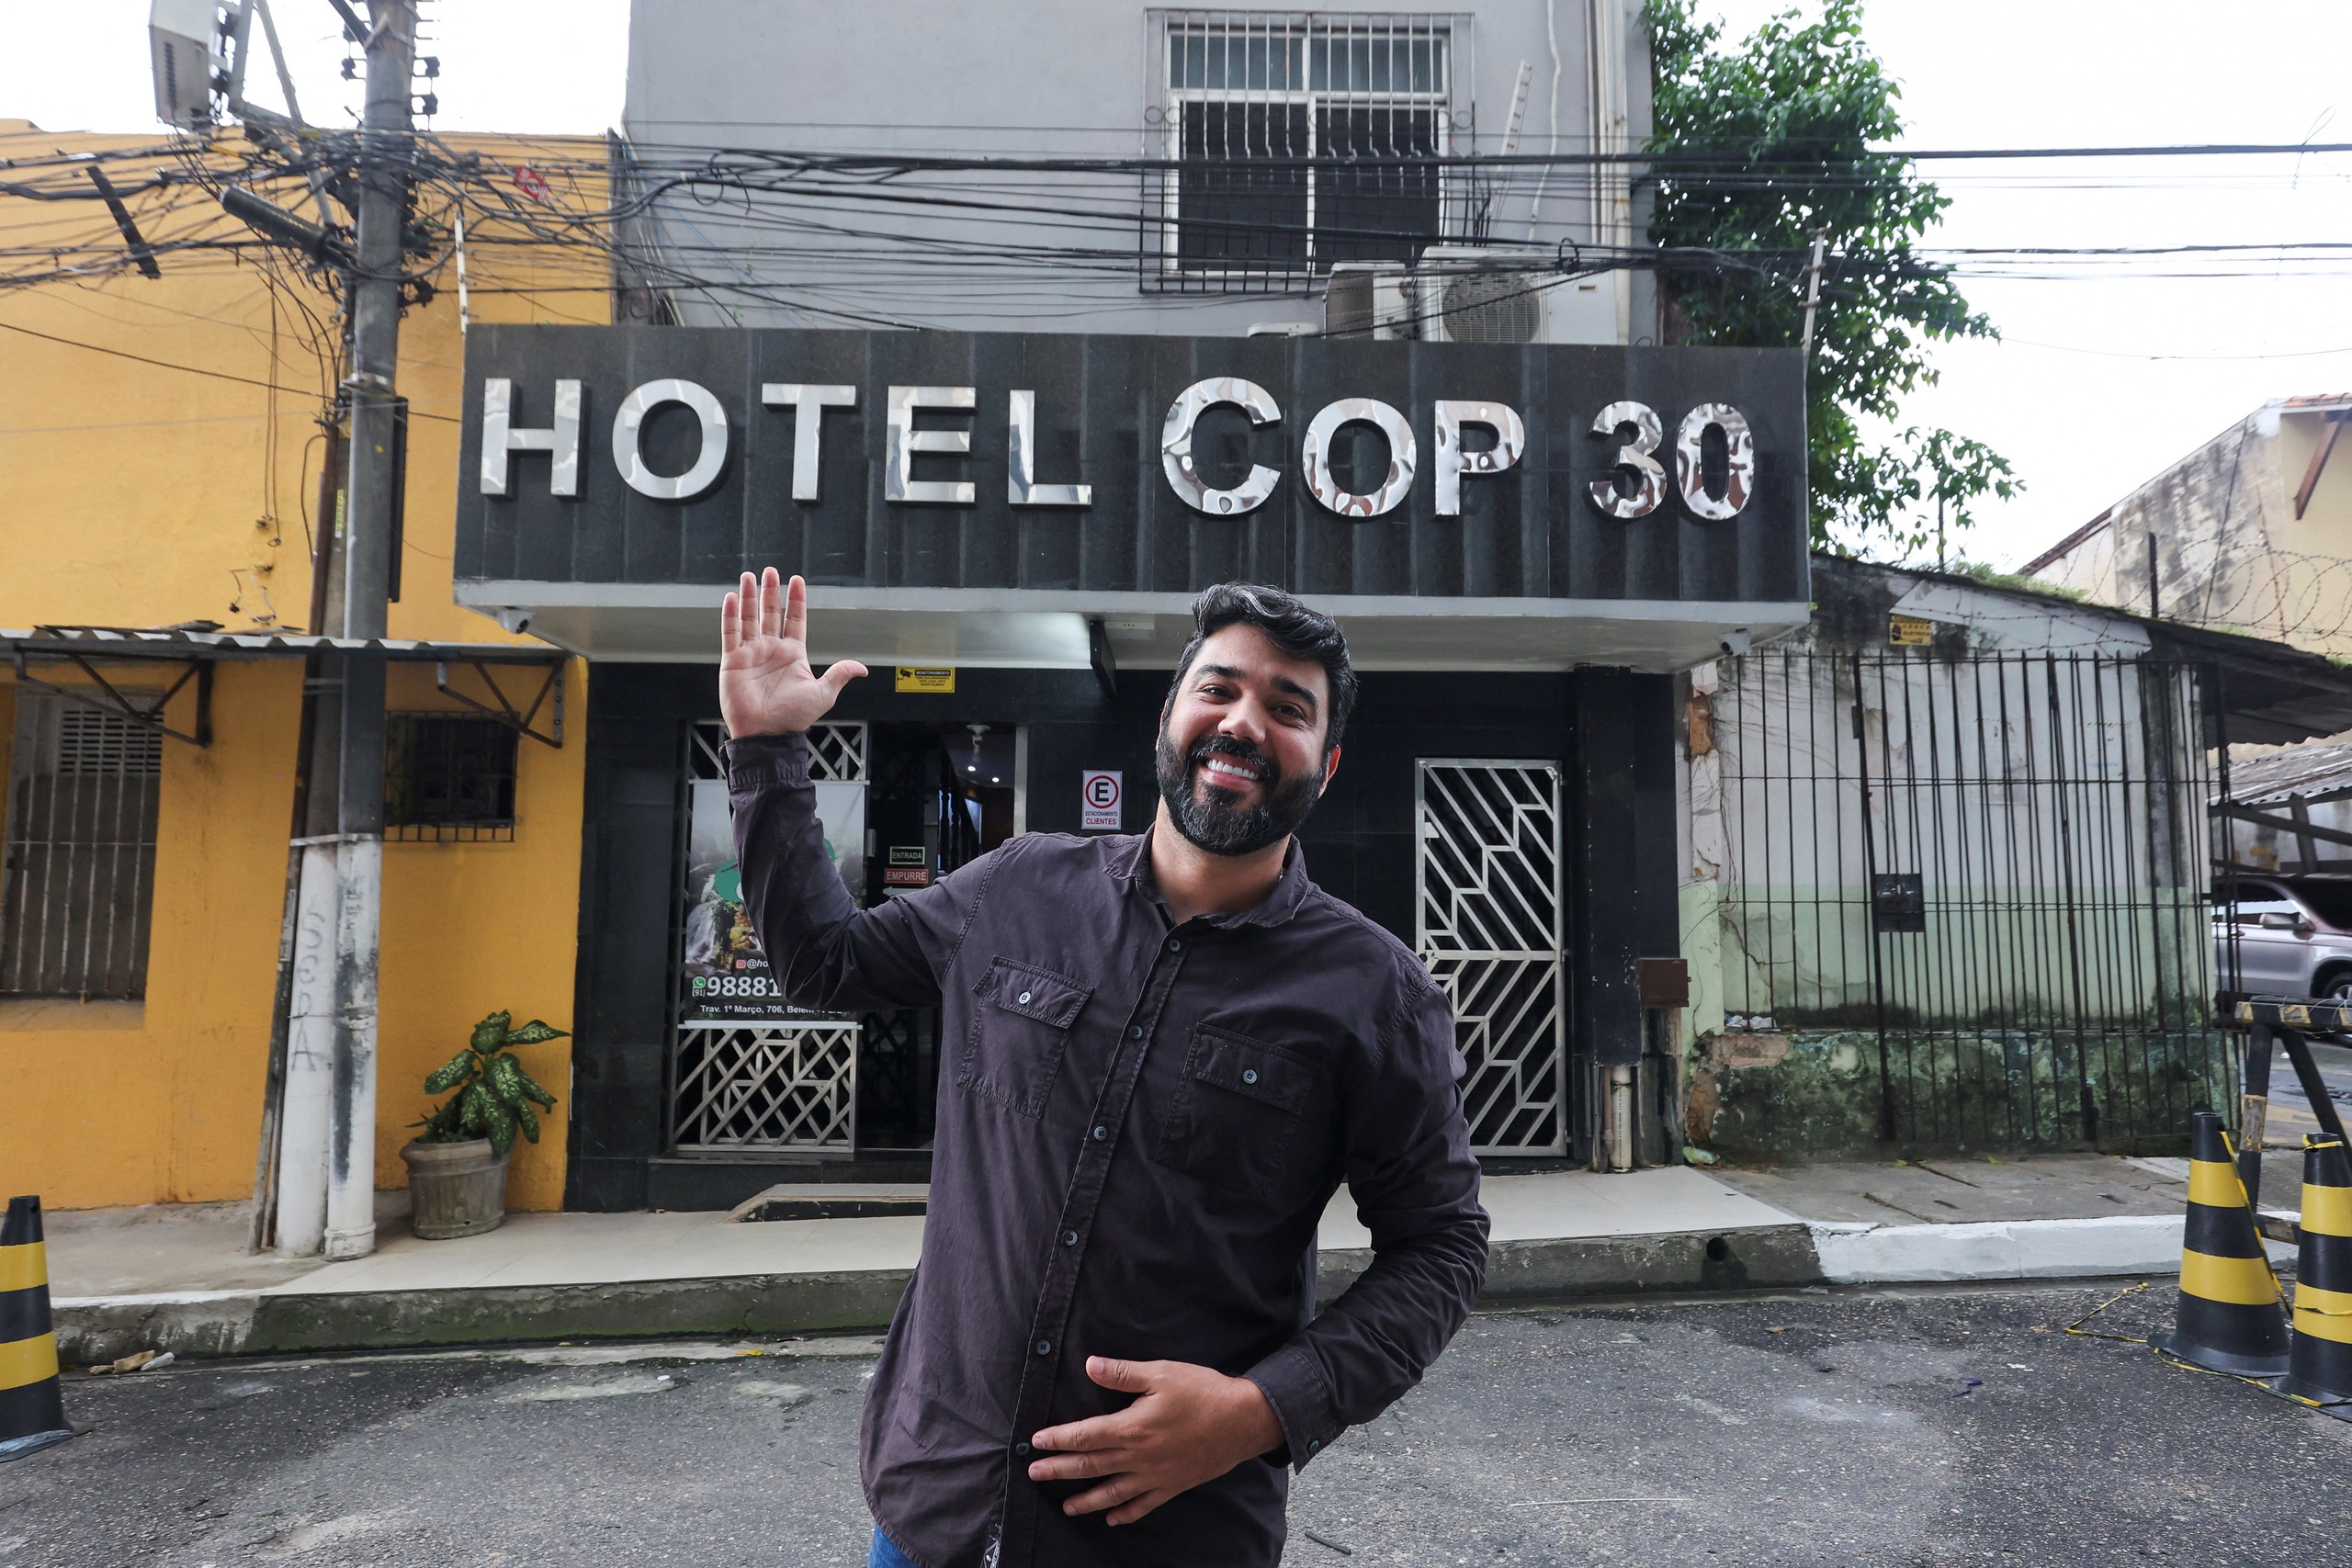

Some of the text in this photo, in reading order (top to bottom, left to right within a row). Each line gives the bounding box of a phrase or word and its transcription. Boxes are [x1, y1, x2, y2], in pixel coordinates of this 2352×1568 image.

[480, 376, 1755, 522] HOTEL COP 30
[1095, 782, 1109, 802] E
[892, 852, 922, 860] ENTRADA
[887, 871, 927, 881] EMPURRE
[692, 988, 706, 998] (91)
[700, 1005, 721, 1013] Trav.
[734, 1005, 764, 1014] Março,
[766, 1005, 785, 1014] 706,
